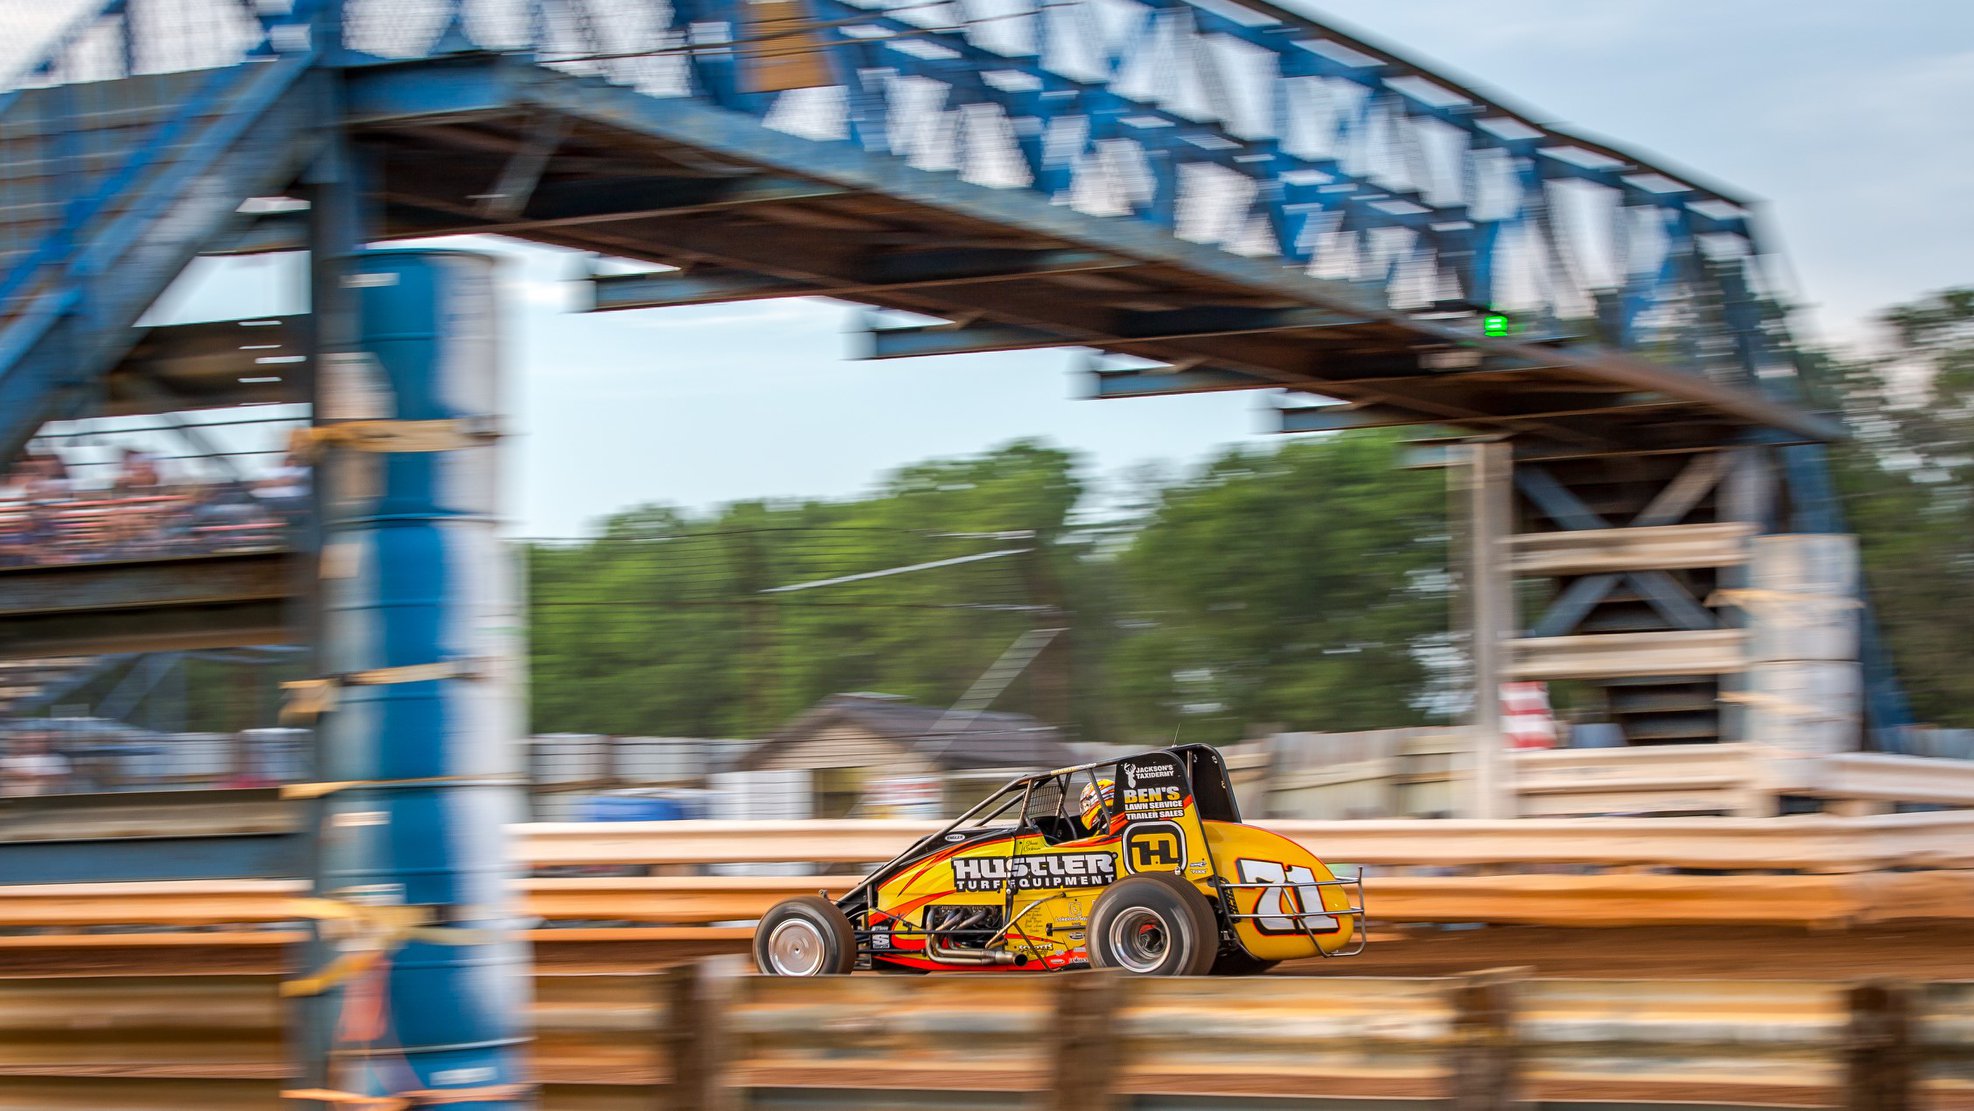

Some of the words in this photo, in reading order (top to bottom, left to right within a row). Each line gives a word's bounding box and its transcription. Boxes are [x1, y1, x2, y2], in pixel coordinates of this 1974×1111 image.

[1136, 764, 1173, 773] JACKSON'S
[1136, 770, 1174, 779] TAXIDERMY
[1123, 786, 1180, 803] BEN'S
[1125, 803, 1148, 811] LAWN
[1149, 800, 1183, 809] SERVICE
[1125, 812, 1159, 820] TRAILER
[1159, 809, 1184, 818] SALES
[953, 853, 1114, 879] HUSTLER
[957, 880, 1000, 890] TURF
[1007, 874, 1115, 888] EQUIPMENT
[1237, 858, 1339, 934] 71
